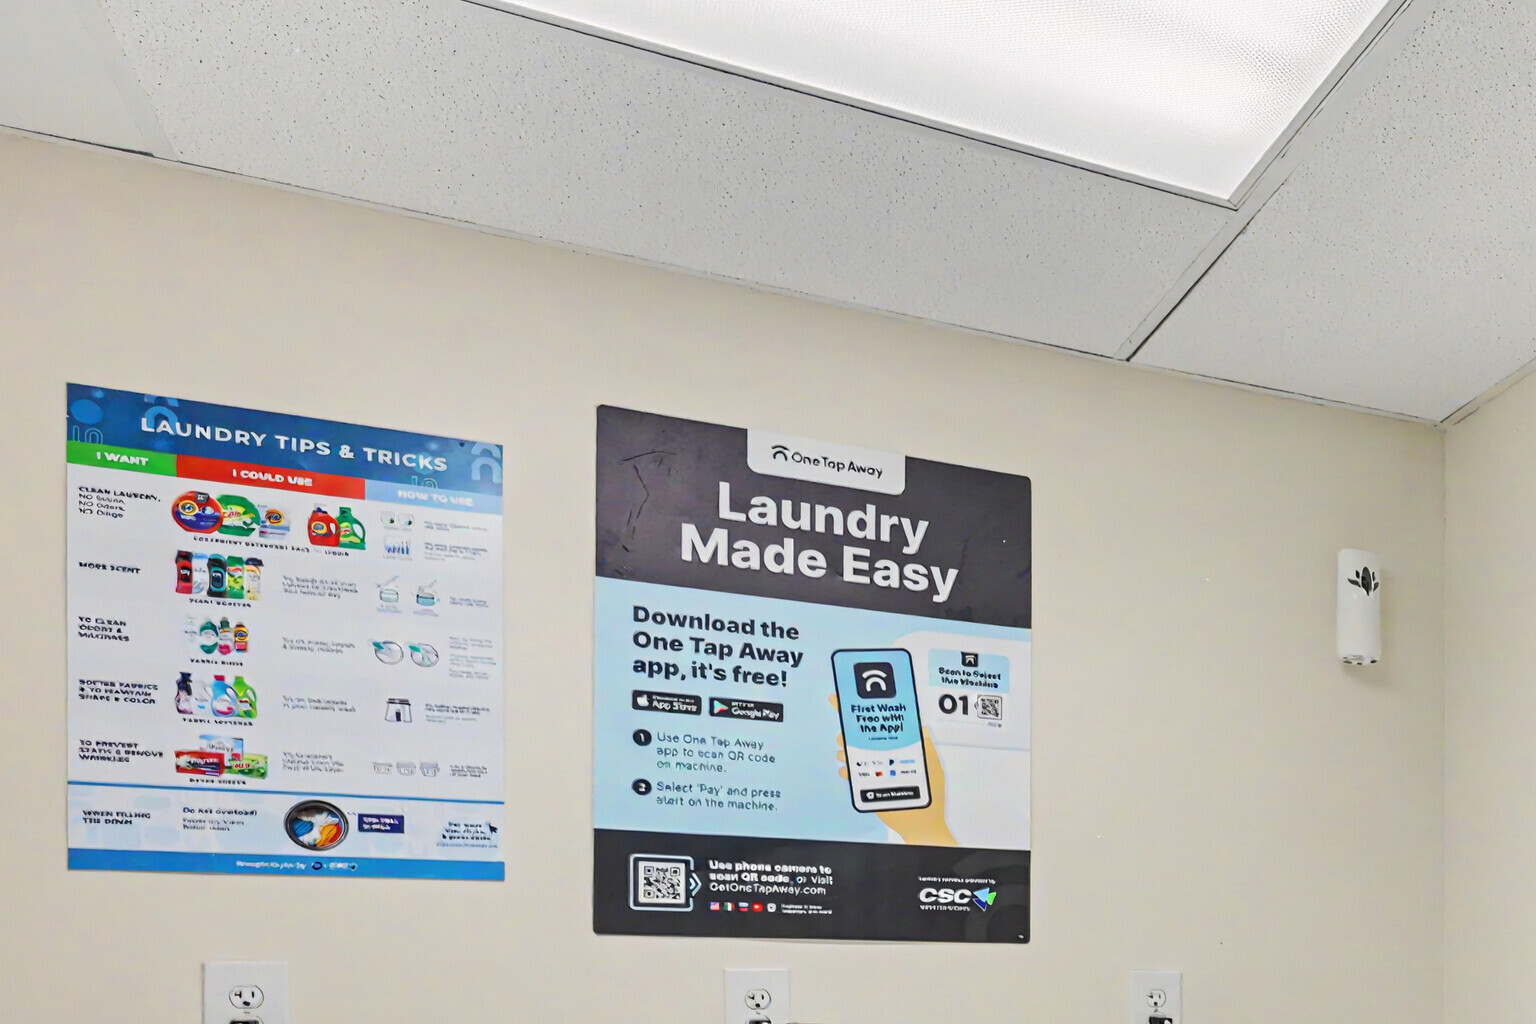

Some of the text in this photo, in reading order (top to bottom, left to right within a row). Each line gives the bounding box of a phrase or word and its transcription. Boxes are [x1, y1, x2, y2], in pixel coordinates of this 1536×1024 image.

[142, 418, 447, 471] LAUNDRY TIPS & TRICKS
[104, 452, 148, 466] WANT
[792, 452, 820, 468] One
[848, 460, 883, 478] Away
[233, 469, 236, 477] I
[240, 470, 284, 483] COULD
[719, 482, 929, 555] Laundry
[681, 523, 958, 603] Made Easy
[633, 605, 799, 640] Download the
[633, 631, 803, 668] One Tap Away
[633, 659, 787, 687] app, it's free!
[939, 694, 968, 715] 01
[657, 732, 763, 750] Use One Tap Away
[657, 748, 776, 763] app to scan QR code
[676, 761, 727, 772] machine.
[657, 782, 693, 793] Select
[727, 787, 748, 796] and
[751, 789, 781, 799] press
[705, 798, 724, 808] the
[728, 800, 778, 811] machine.
[919, 888, 972, 904] CSC
